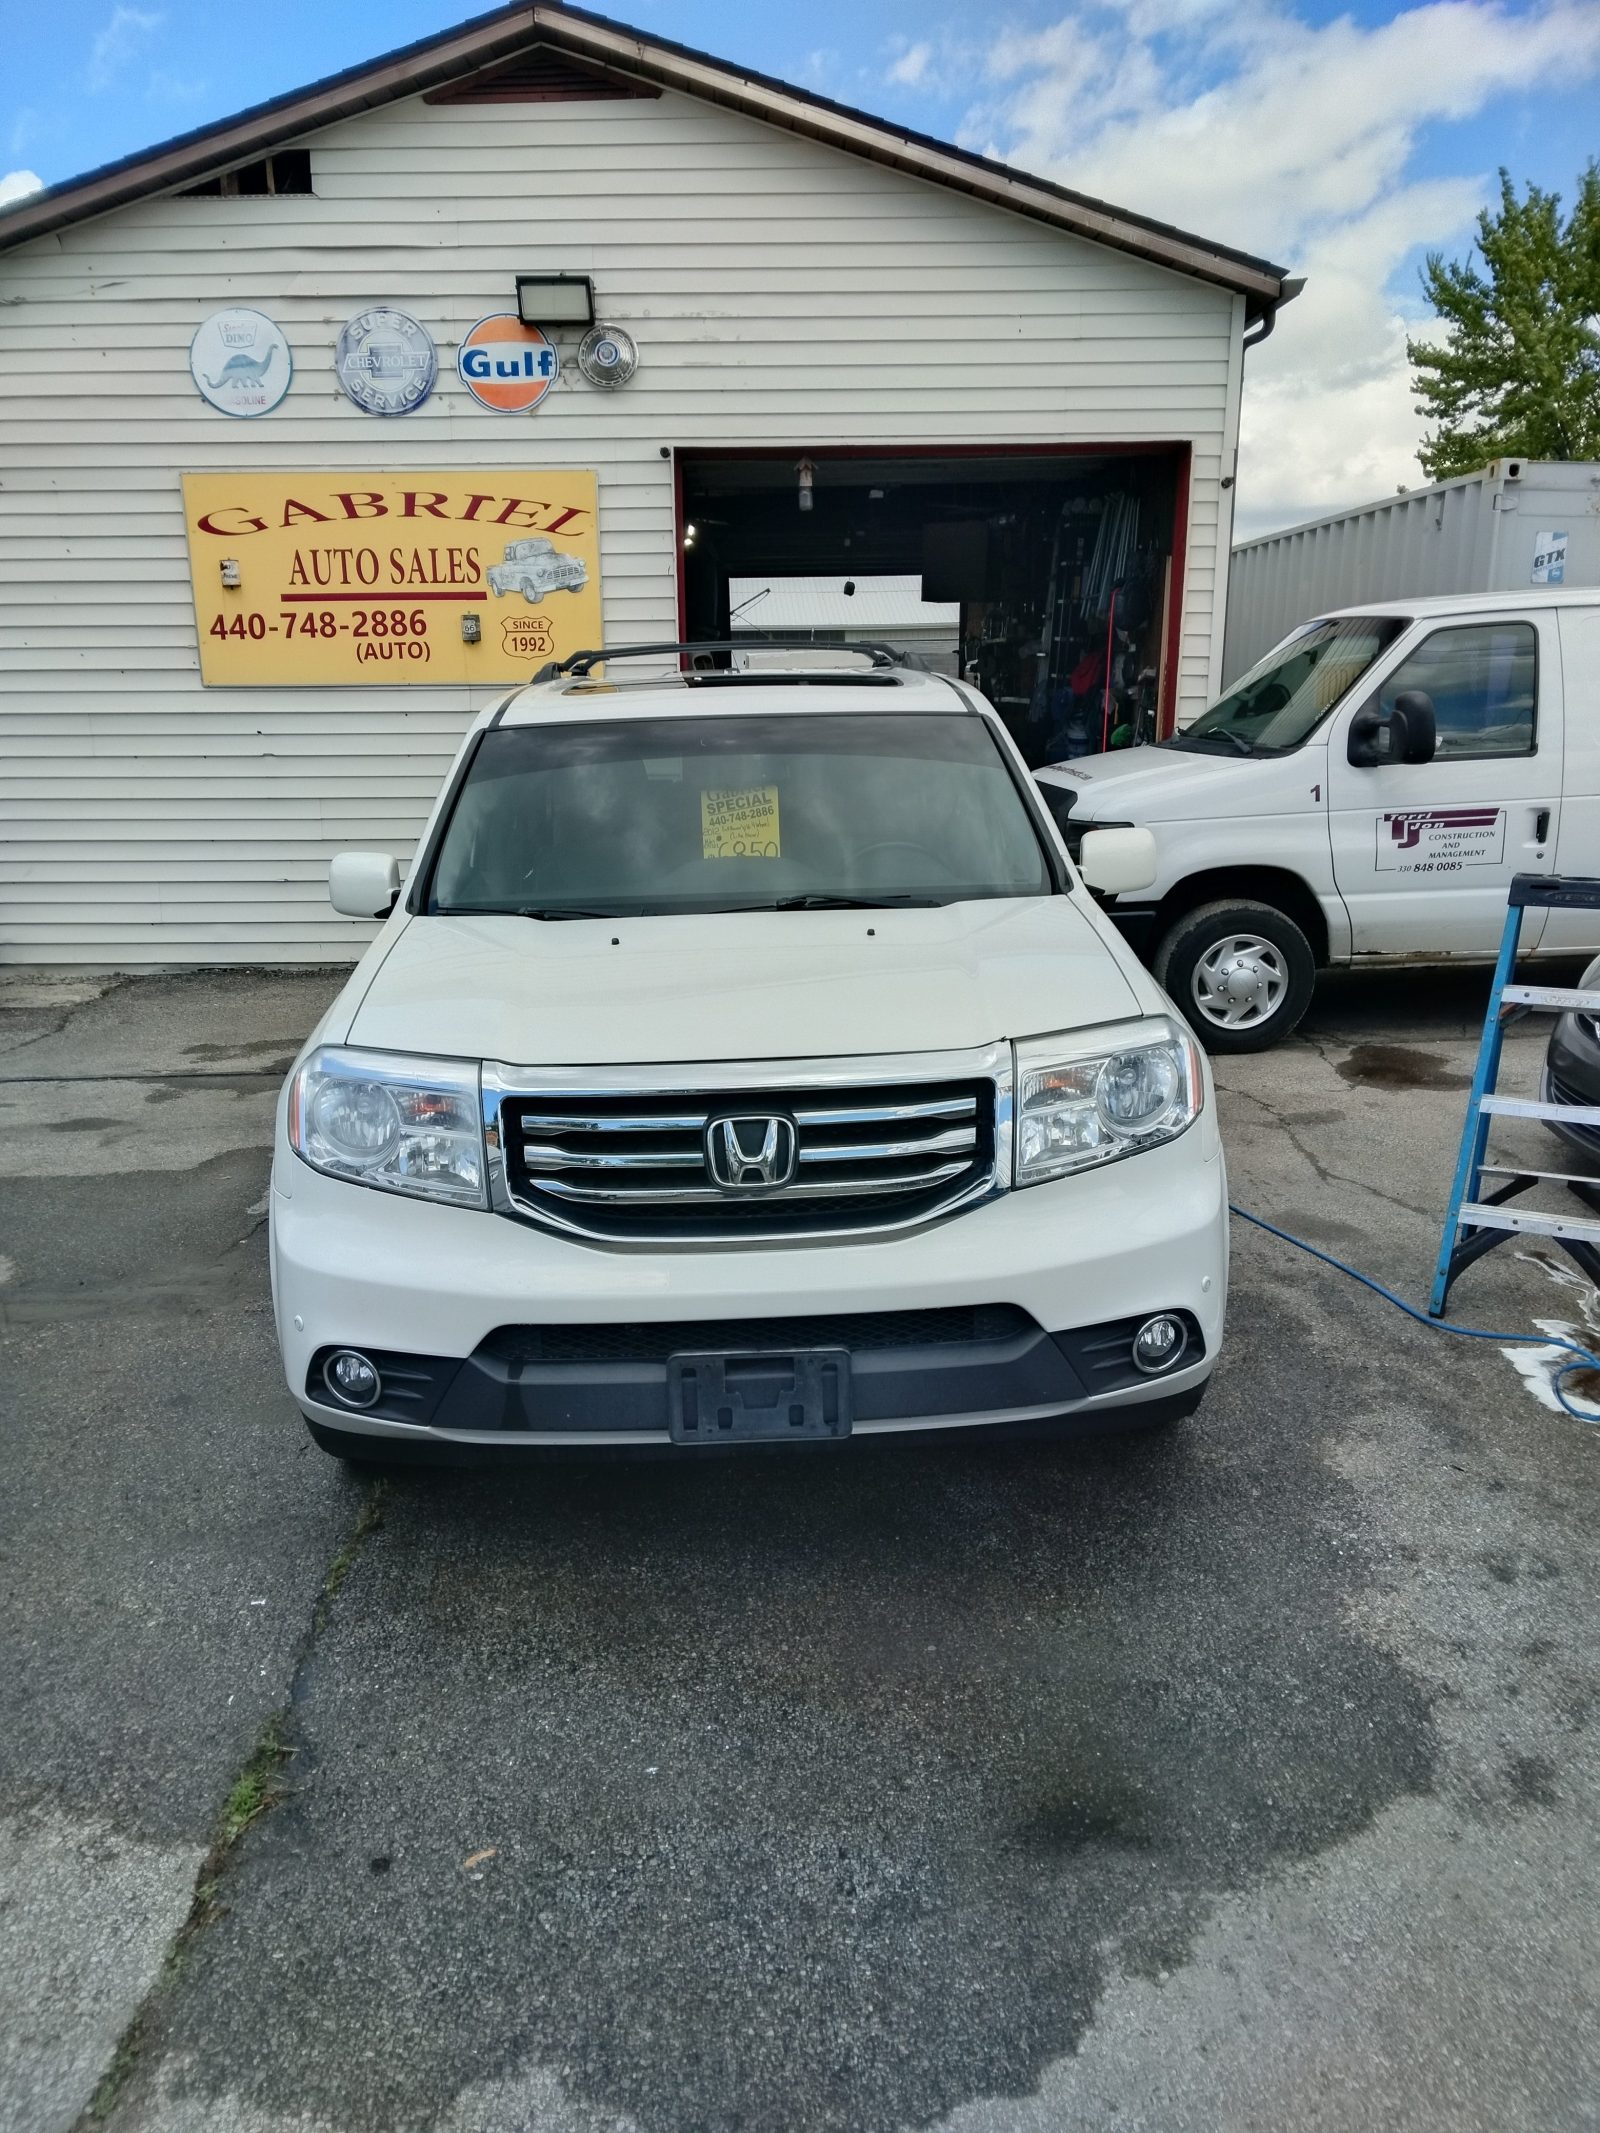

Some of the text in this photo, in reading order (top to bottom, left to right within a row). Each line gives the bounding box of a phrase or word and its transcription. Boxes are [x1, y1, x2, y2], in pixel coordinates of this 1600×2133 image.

[349, 312, 417, 340] SUPER
[225, 333, 253, 344] DINO
[347, 355, 425, 369] CHEVROLET
[462, 349, 553, 378] Gulf
[350, 377, 427, 410] SERVICE
[197, 491, 591, 537] GABRIEL
[288, 546, 482, 586] AUTO SALES
[1533, 548, 1566, 569] GTX
[209, 608, 428, 641] 440-748-2886
[464, 624, 475, 632] 66
[512, 620, 544, 629] SINCE
[356, 641, 431, 663] (AUTO)
[511, 637, 546, 652] 1992
[1310, 784, 1321, 802] 1
[706, 792, 773, 815] SPECIAL
[709, 805, 775, 827] 440-748-2886
[1390, 812, 1433, 821] Terri
[1410, 822, 1445, 830] Jon
[1428, 831, 1496, 841] CONSTRUCTION
[1428, 849, 1487, 859] MANAGEMENT
[1413, 863, 1434, 872] 848
[1436, 862, 1463, 871] 0085
